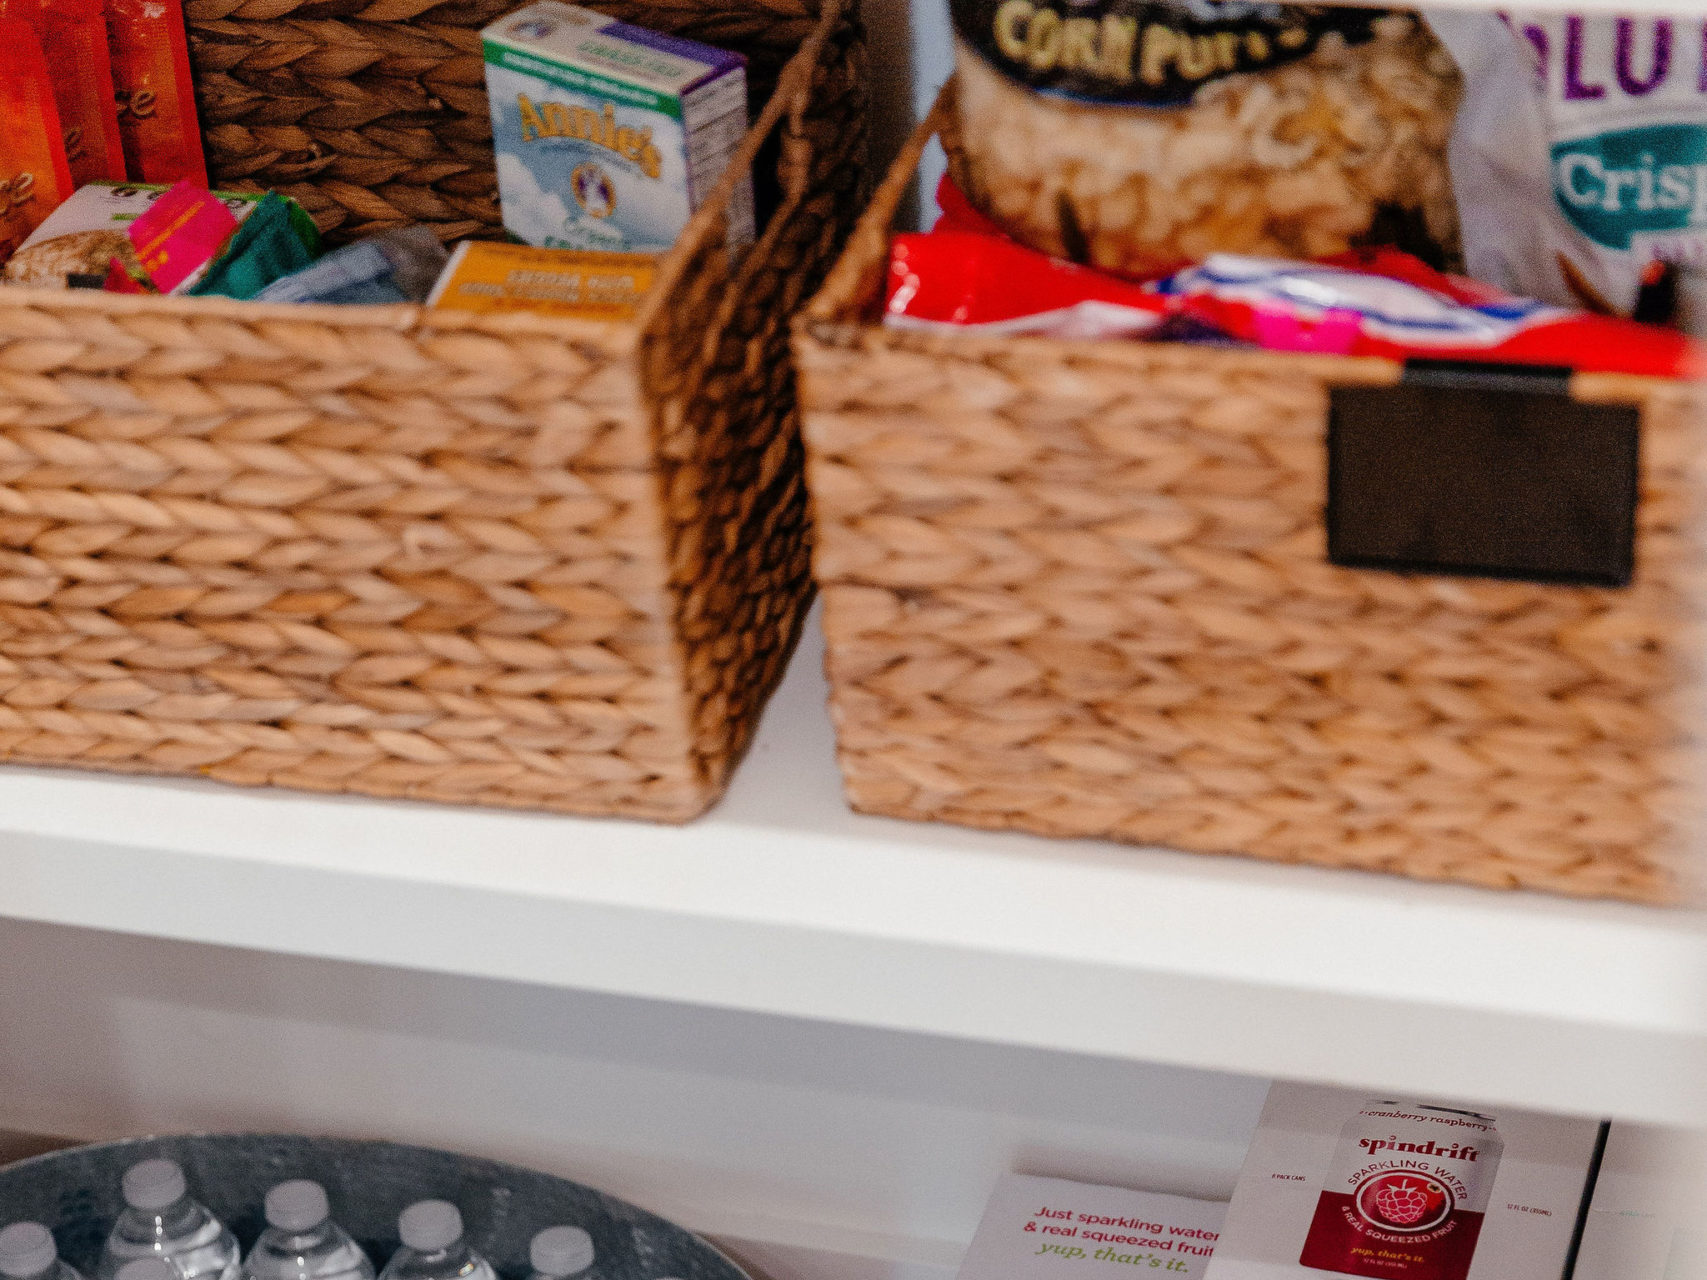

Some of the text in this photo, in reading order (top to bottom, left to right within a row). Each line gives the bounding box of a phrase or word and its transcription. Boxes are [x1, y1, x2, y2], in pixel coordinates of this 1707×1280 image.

[994, 0, 1137, 86] CORN
[1367, 1109, 1490, 1132] cranberry raspberry
[1358, 1135, 1480, 1162] spindrift
[1347, 1159, 1468, 1201] SPARKLING WATER
[1023, 1222, 1214, 1259] & real squeezed fruit
[1034, 1205, 1220, 1242] Just sparkling water
[1344, 1212, 1363, 1233] REAL
[1365, 1227, 1432, 1244] SQUEEZED
[1431, 1219, 1458, 1239] FRUIT
[1034, 1242, 1190, 1273] yup, that's it.
